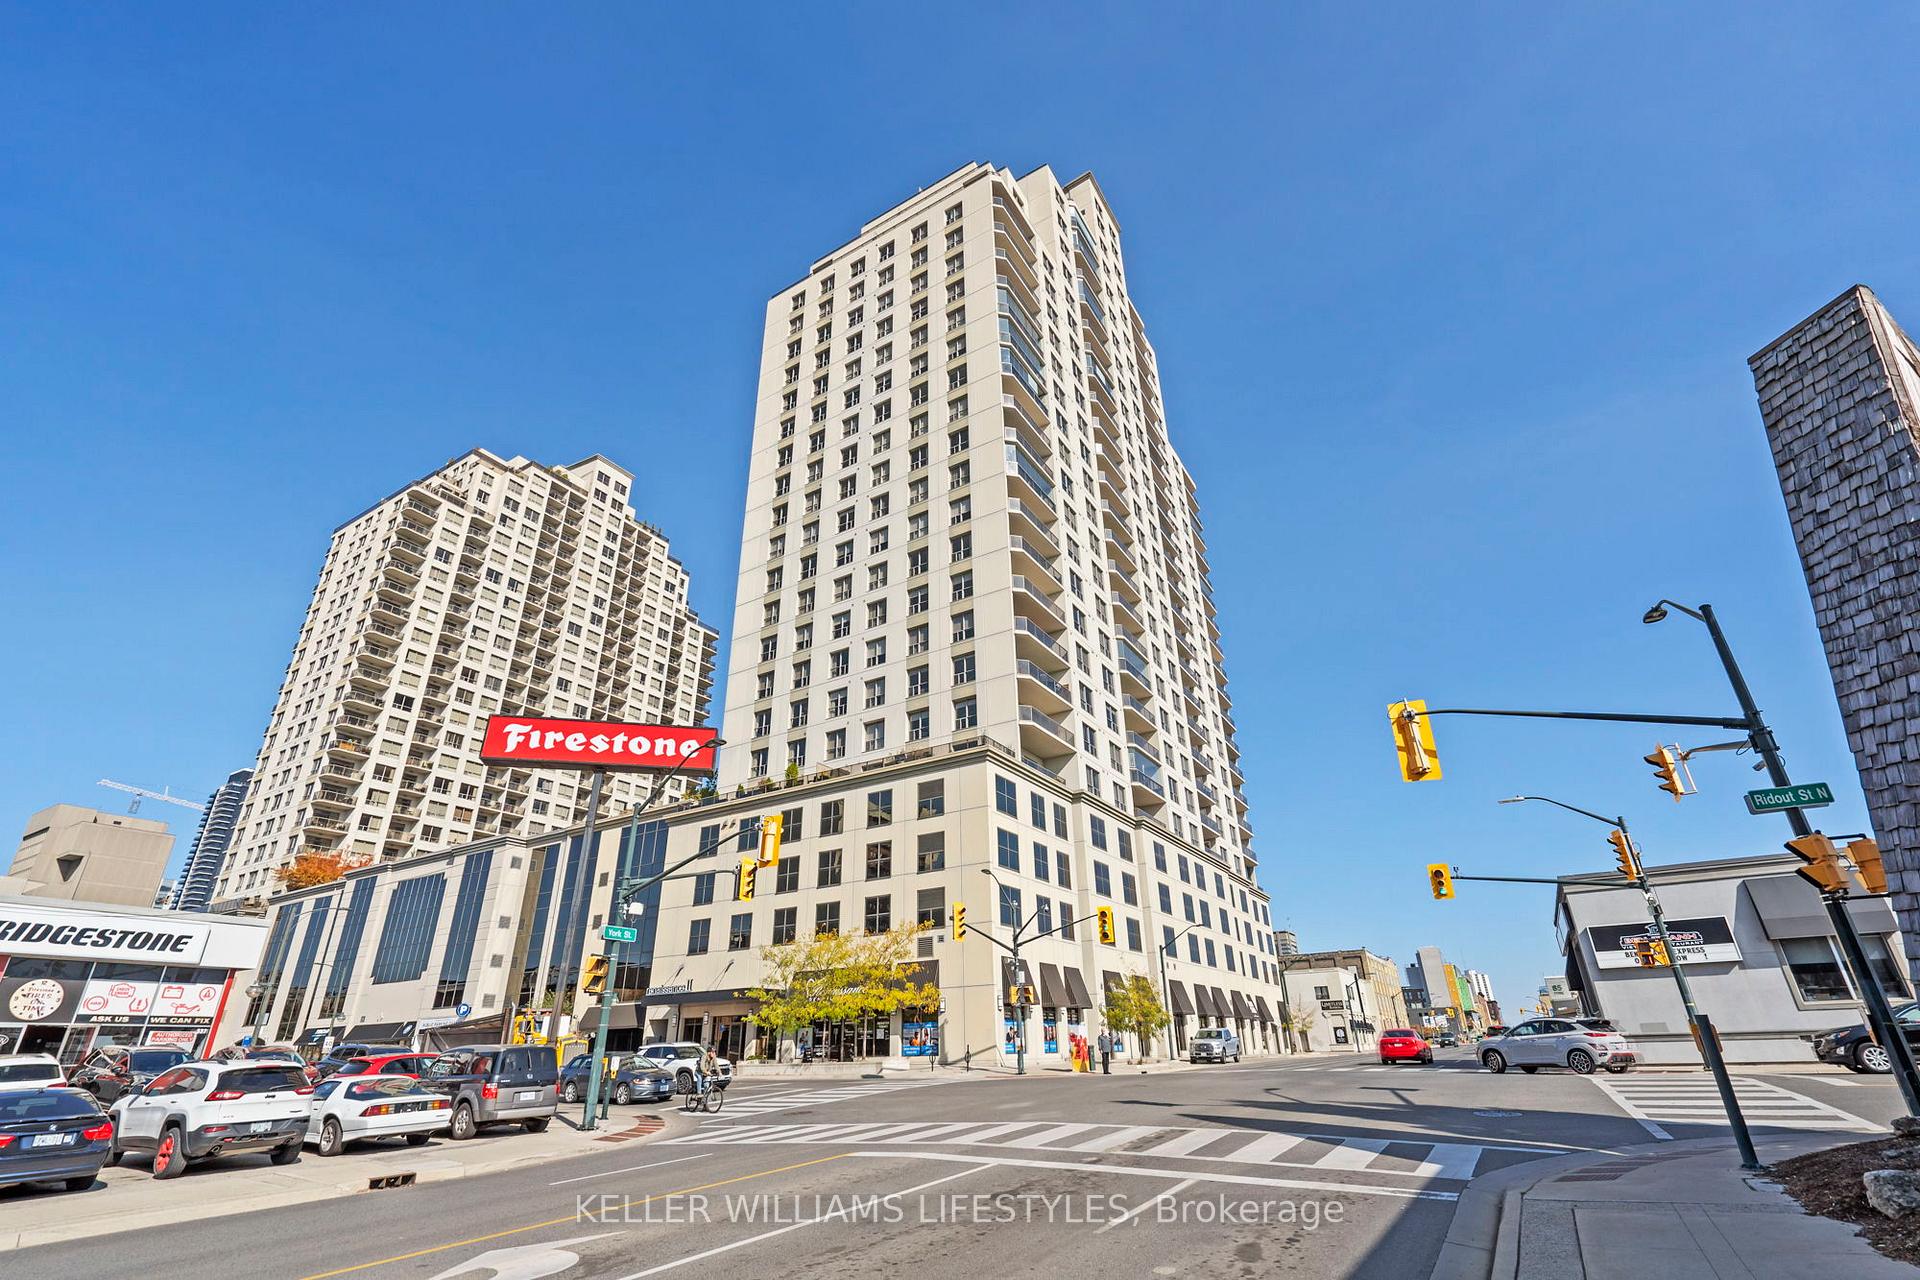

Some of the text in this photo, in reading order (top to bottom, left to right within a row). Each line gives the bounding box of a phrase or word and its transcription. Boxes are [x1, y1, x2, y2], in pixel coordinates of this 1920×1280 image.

[503, 723, 700, 758] Firestone
[1753, 787, 1828, 806] Ridout St N
[0, 920, 193, 952] RIDGESTONE
[608, 929, 622, 938] York
[460, 1005, 468, 1014] P
[89, 1015, 113, 1023] ASK
